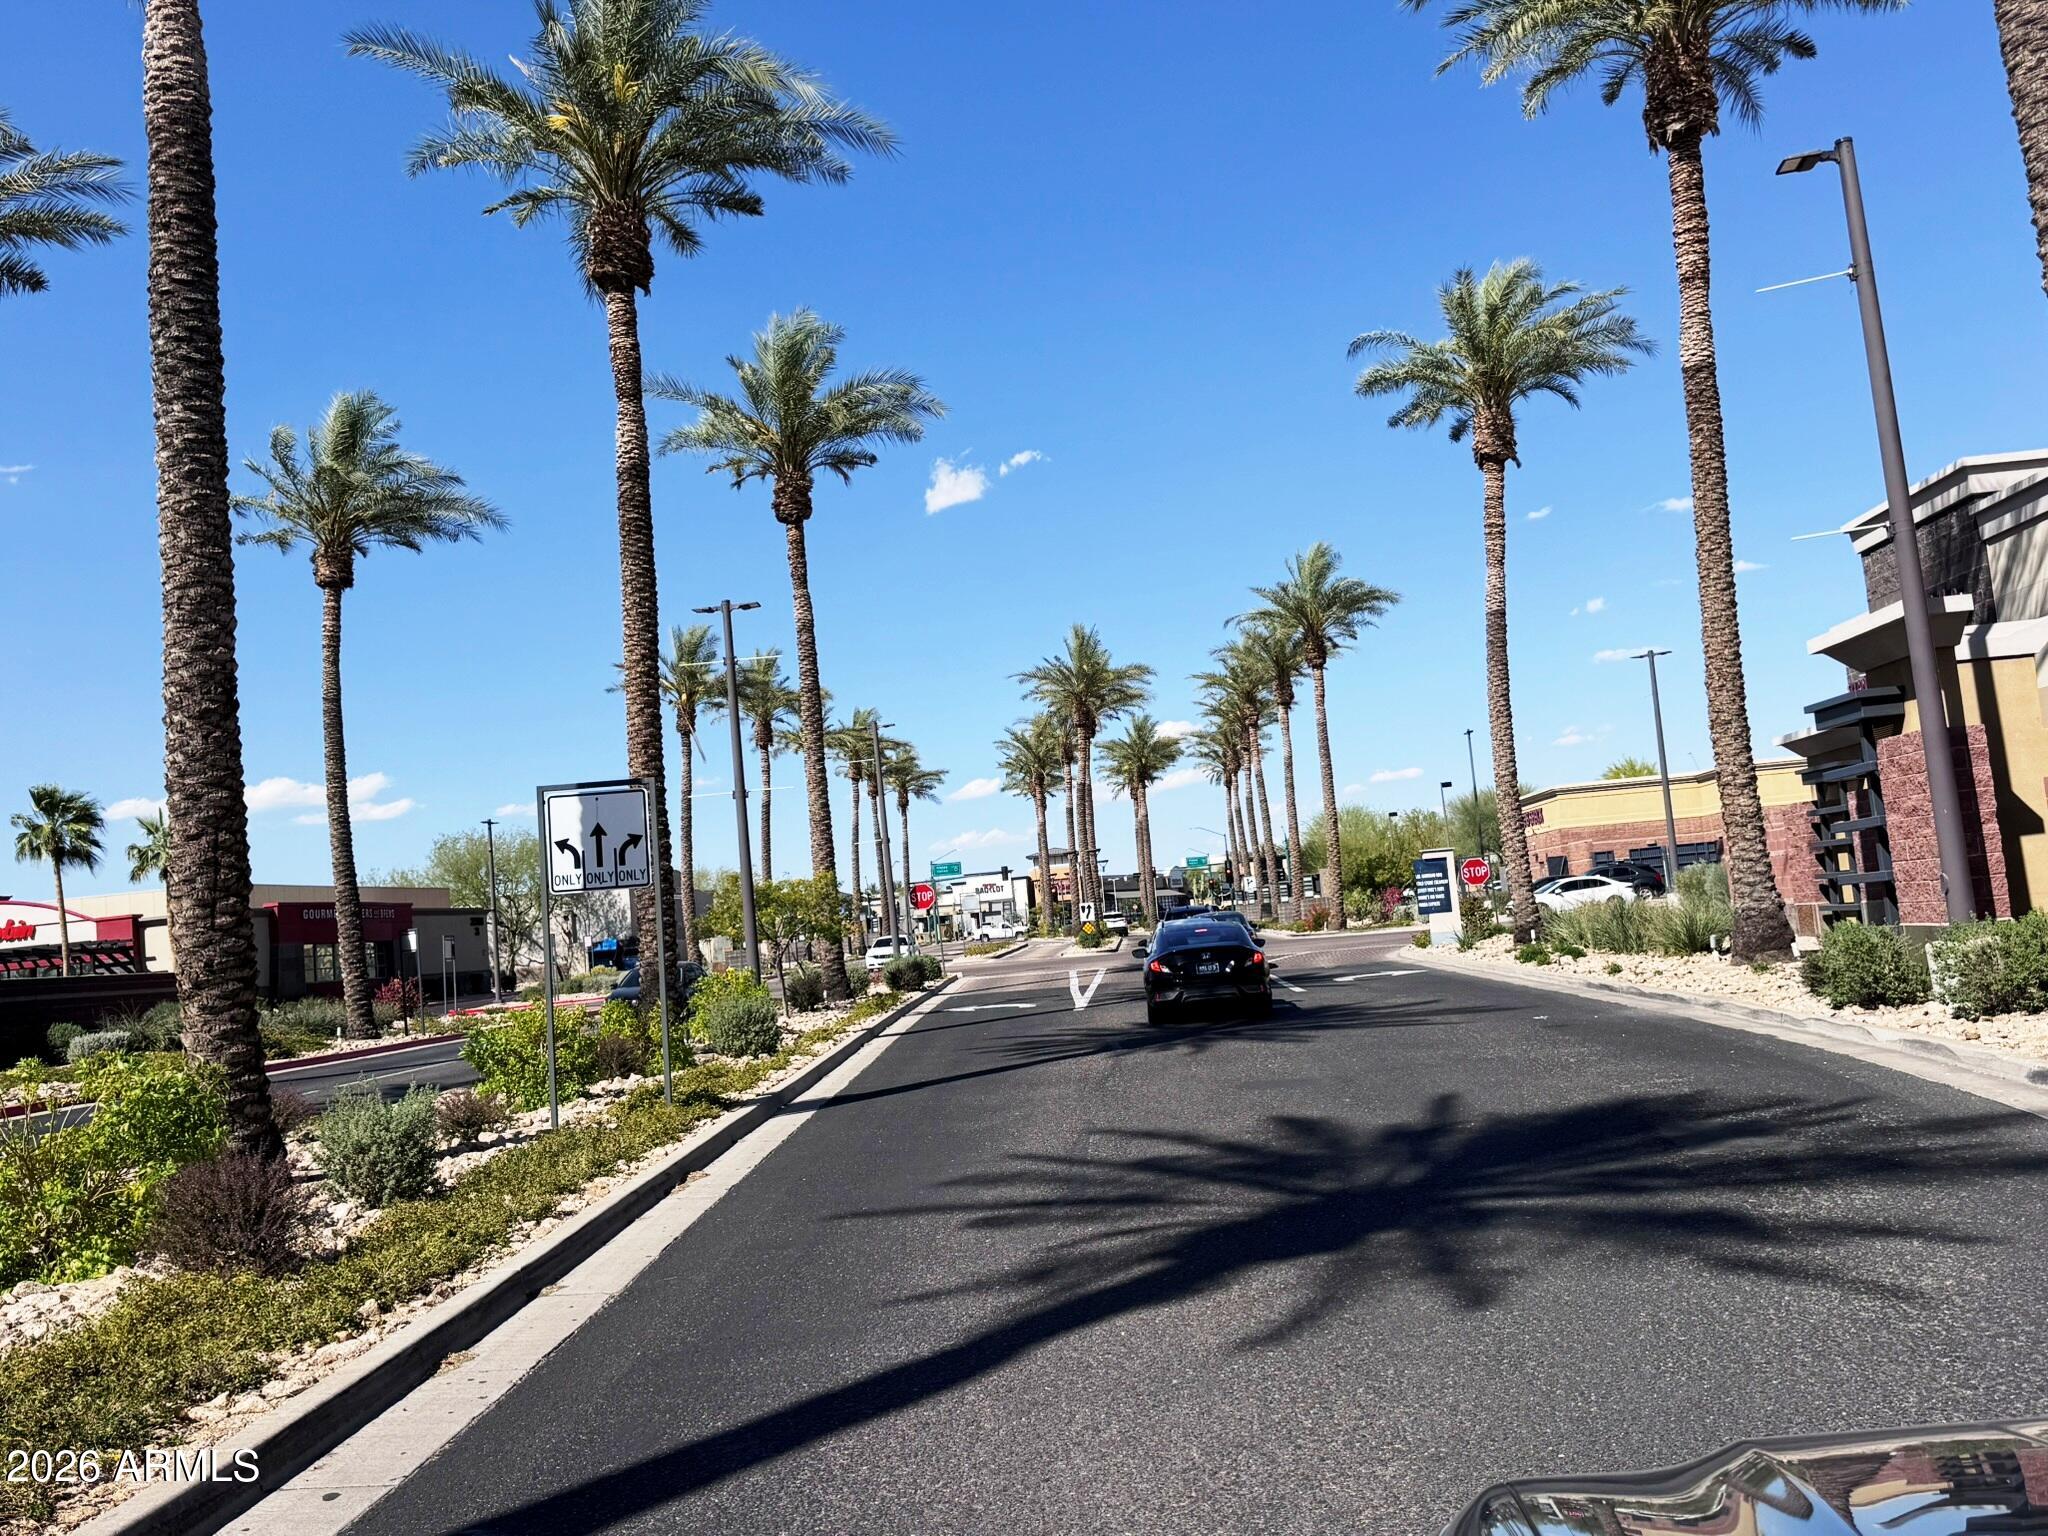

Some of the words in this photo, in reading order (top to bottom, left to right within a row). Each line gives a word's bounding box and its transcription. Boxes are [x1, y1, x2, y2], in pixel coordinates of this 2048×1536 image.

[554, 874, 582, 887] ONLY
[586, 871, 614, 885] ONLY
[619, 868, 646, 882] ONLY
[1463, 866, 1487, 878] STOP
[911, 891, 933, 903] STOP
[303, 909, 337, 920] GOURM
